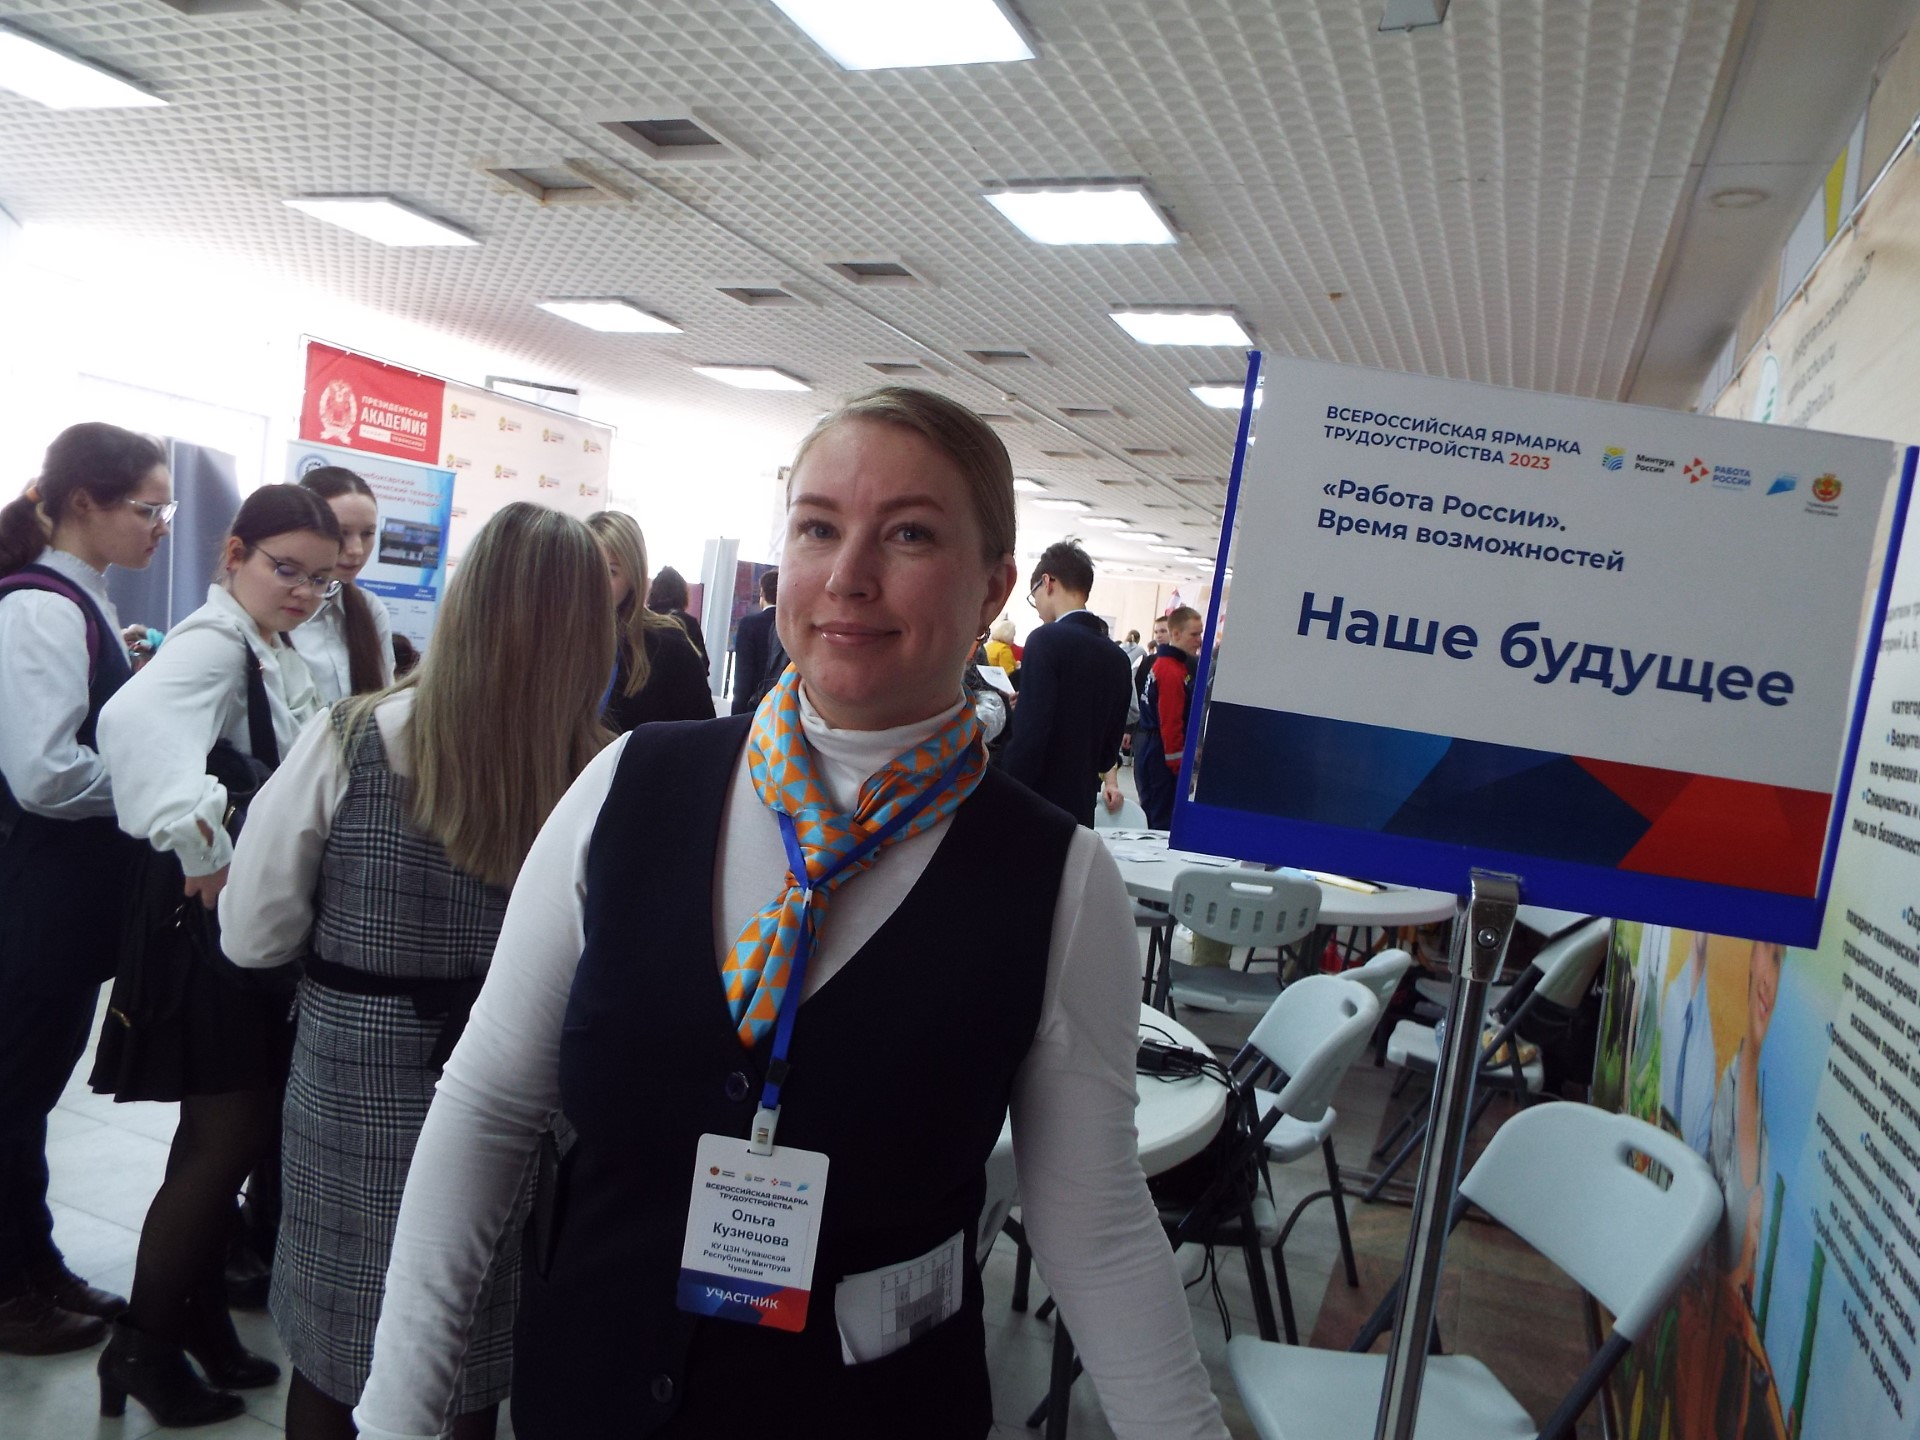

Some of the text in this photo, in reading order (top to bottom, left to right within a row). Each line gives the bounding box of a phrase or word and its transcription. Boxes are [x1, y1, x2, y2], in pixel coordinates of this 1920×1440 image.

[361, 395, 429, 419] ПРЕЗИДЕНТСКАЯ
[360, 407, 428, 437] АКАДЕМИЯ
[1326, 405, 1582, 455] ВСЕРОССИЙСКАЯ ЯРМАРКА
[1323, 425, 1550, 470] ТРУДОУСТРОЙСТВА 2023
[1634, 462, 1666, 474] России
[1636, 454, 1675, 468] Минтруд
[1713, 465, 1751, 477] РАБОТА
[1712, 474, 1751, 486] РОССИИ
[1323, 479, 1566, 532] «Работа России».
[1318, 508, 1624, 573] Время возможностей
[1296, 591, 1795, 707] Наше будущее
[1878, 821, 1920, 857] безопасност
[1884, 966, 1917, 1004] оборона
[705, 1182, 771, 1199] ВСЕРОССИЙСКАЯ
[772, 1194, 809, 1206] ЯРМАРКА
[719, 1192, 793, 1210] ТРУДОУСТРОЙСТВА
[732, 1208, 776, 1227] Ольга
[713, 1222, 790, 1247] Кузнецова
[703, 1249, 791, 1273] Республики Минтруда
[711, 1241, 786, 1262] КУ ЦЗН Чувашской
[728, 1263, 764, 1276] Чувашии
[705, 1286, 778, 1309] УЧАСТНИК
[1874, 1311, 1911, 1382] обучение
